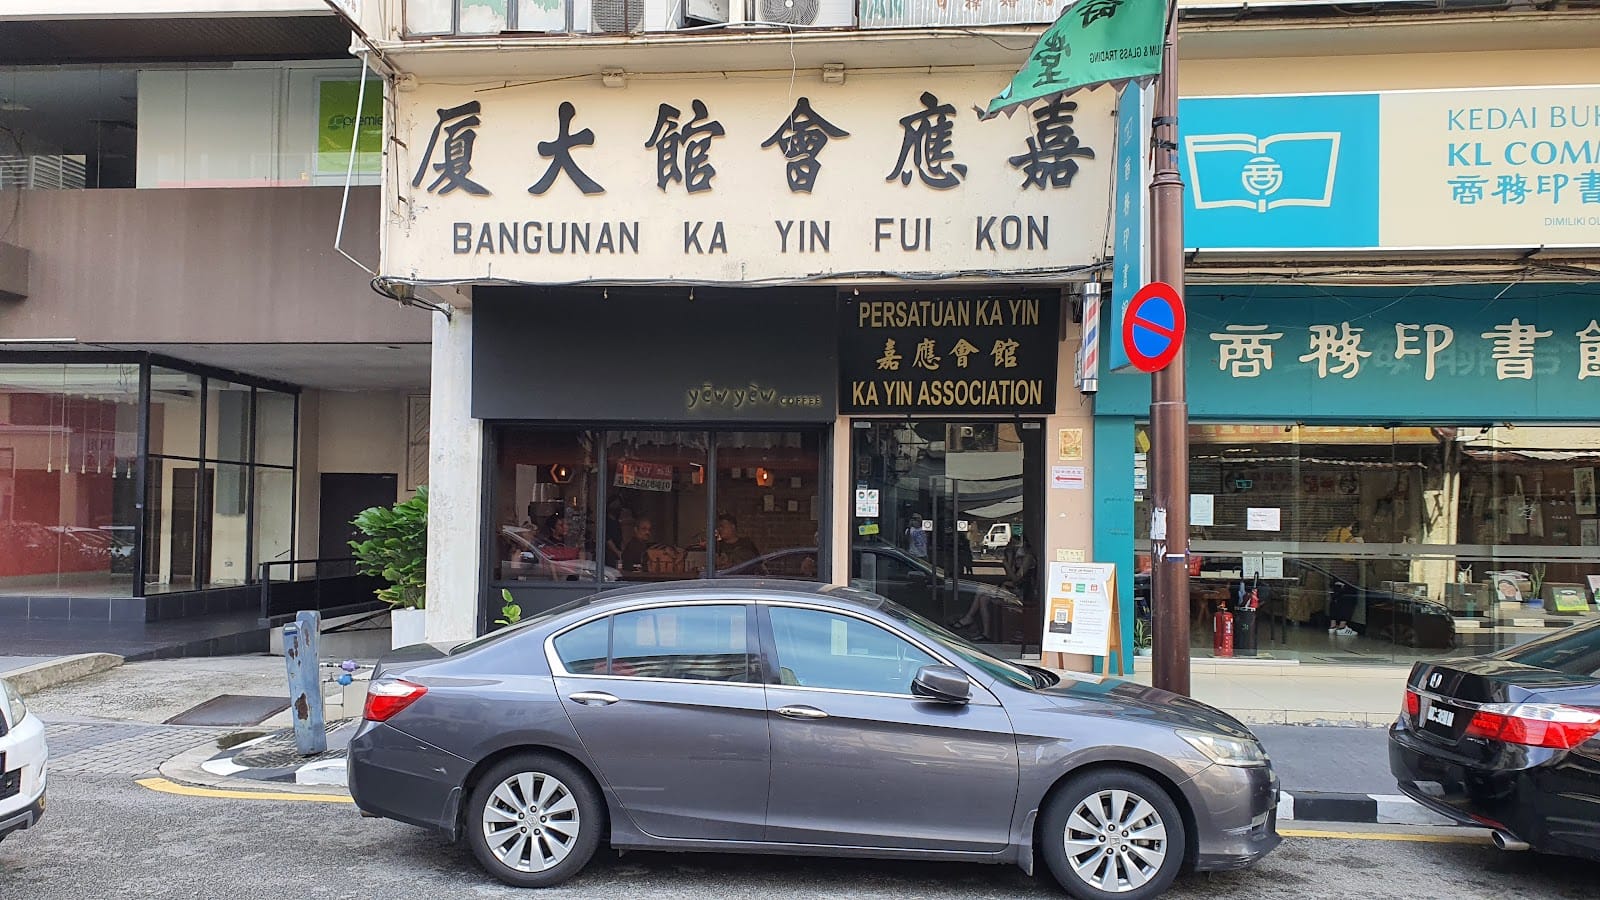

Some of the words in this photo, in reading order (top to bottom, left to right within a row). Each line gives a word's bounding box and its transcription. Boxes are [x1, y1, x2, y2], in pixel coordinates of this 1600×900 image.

[1448, 107, 1536, 131] KEDAI
[1448, 142, 1492, 167] KL
[1504, 140, 1600, 166] COM
[453, 221, 639, 254] BANGUNAN
[684, 221, 728, 253] KA
[775, 220, 831, 253] YIN
[875, 217, 932, 252] FUI
[975, 215, 1049, 250] KON
[1544, 217, 1586, 227] DIMILIKI
[859, 300, 970, 328] PERSATUAN
[975, 300, 1003, 326] KA
[1009, 299, 1039, 326] YIN
[876, 338, 1020, 371] 嘉應會館
[780, 395, 822, 406] COFFEE
[853, 381, 879, 406] KA
[884, 381, 912, 406] YIN
[917, 380, 1043, 406] ASSOCIATION
